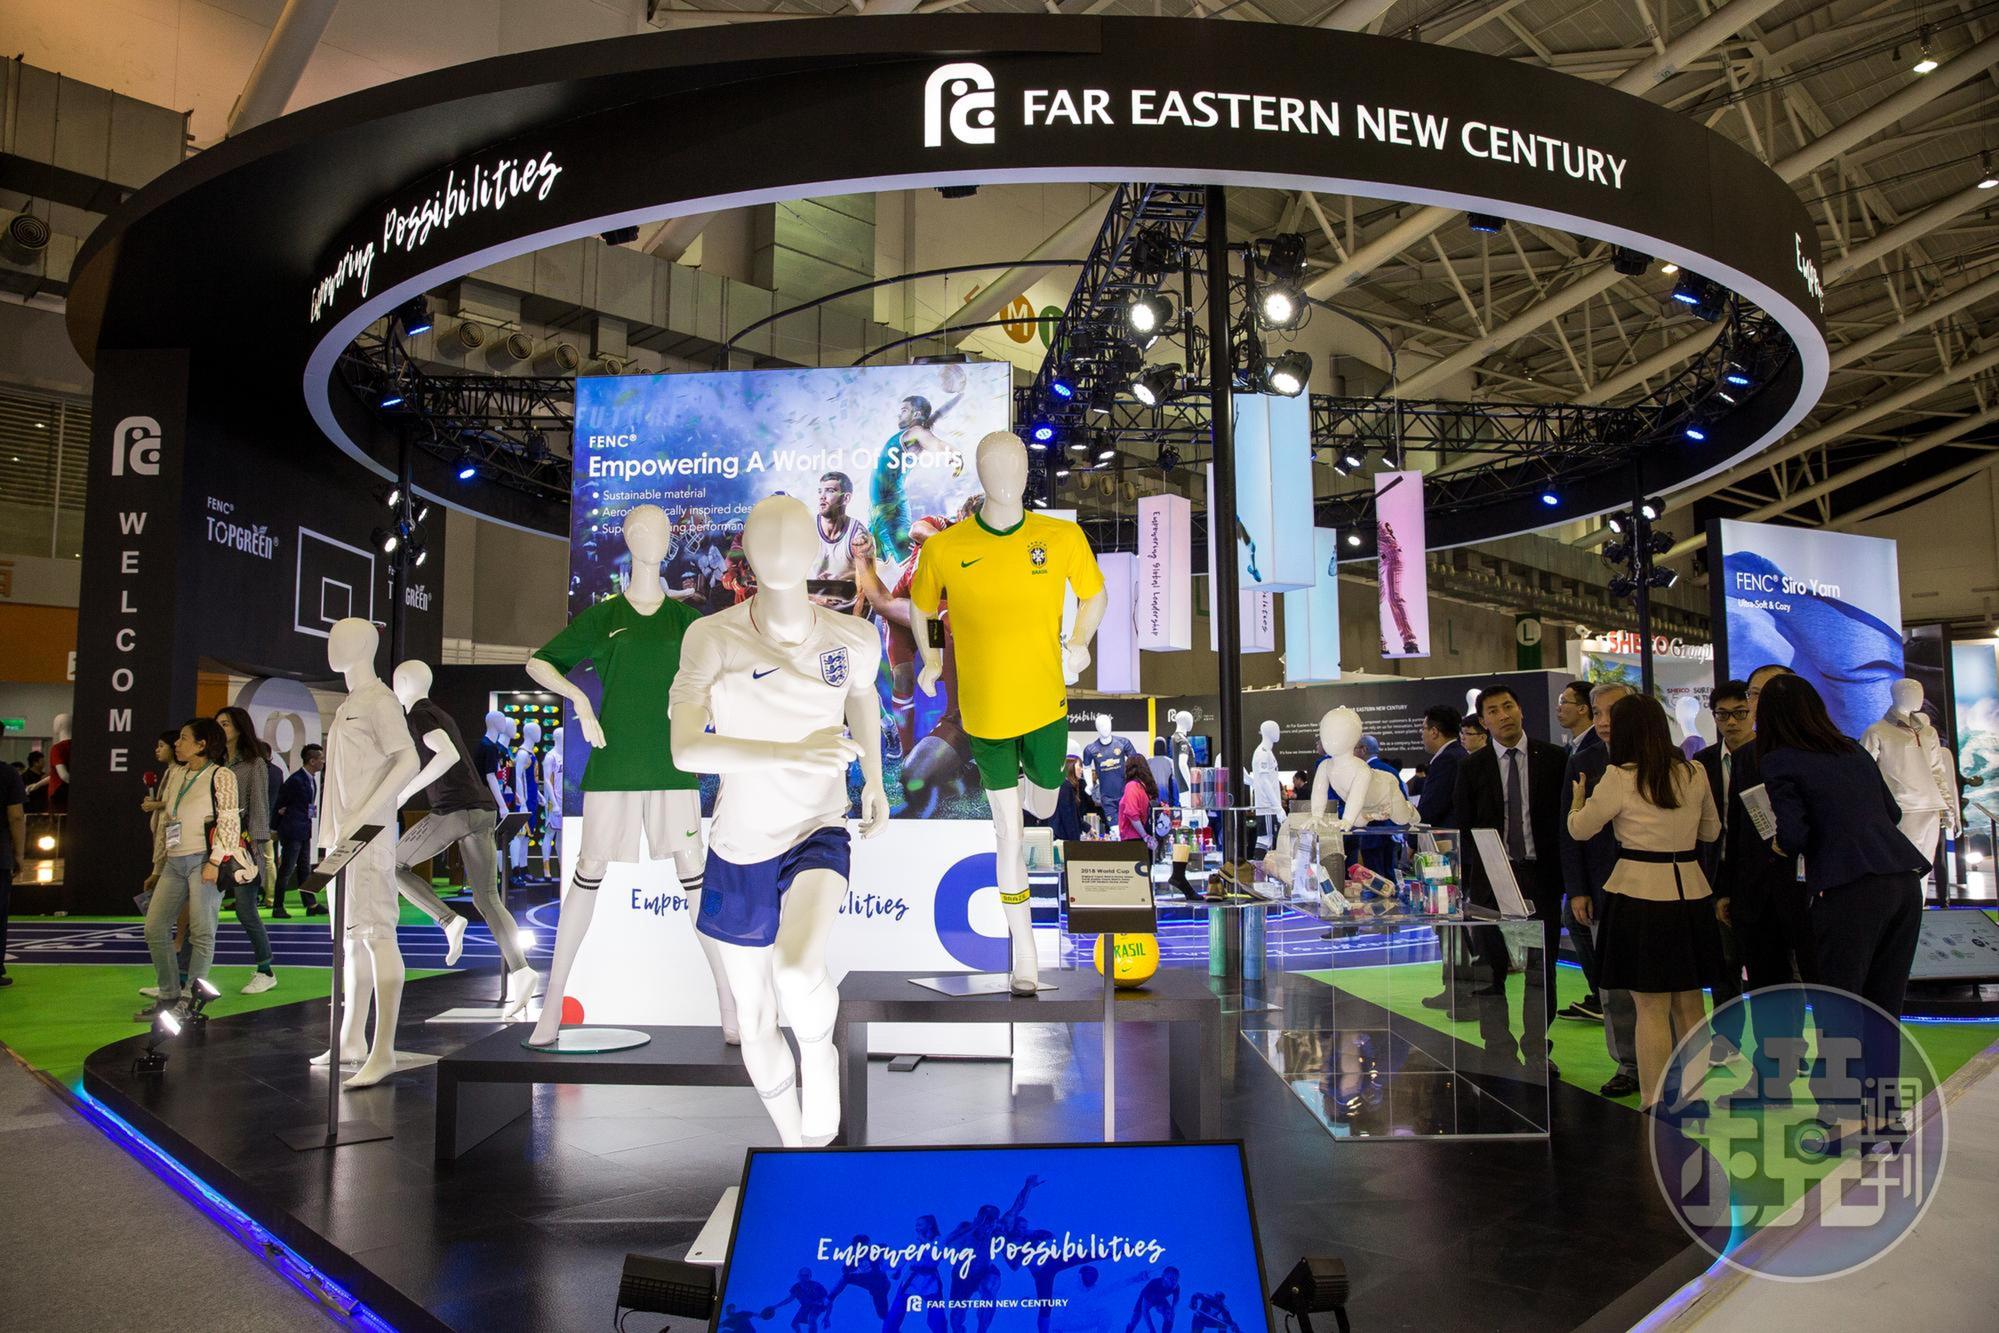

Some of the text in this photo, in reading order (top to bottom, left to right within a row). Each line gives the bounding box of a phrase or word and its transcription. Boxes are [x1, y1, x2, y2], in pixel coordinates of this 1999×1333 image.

[1024, 89, 1628, 190] FAR EASTERN NEW CENTURY
[310, 151, 563, 324] Empowering Possibilities
[588, 444, 963, 481] Empowering A World Of Sports
[603, 487, 706, 501] Sustainable material
[689, 503, 732, 518] inspired
[689, 520, 745, 534] performan
[1782, 576, 1807, 596] Siro
[1809, 578, 1841, 598] Yarn
[1150, 592, 1161, 637] Leadership
[1768, 601, 1775, 610] &
[1775, 601, 1791, 613] Cozy
[109, 511, 148, 772] WELCOME
[1523, 623, 1534, 641] L
[1113, 942, 1146, 959] RASIL
[816, 1231, 1167, 1280] Empowering Possibilities
[926, 1298, 1069, 1309] FAR EASTERN NEW CENTURY
